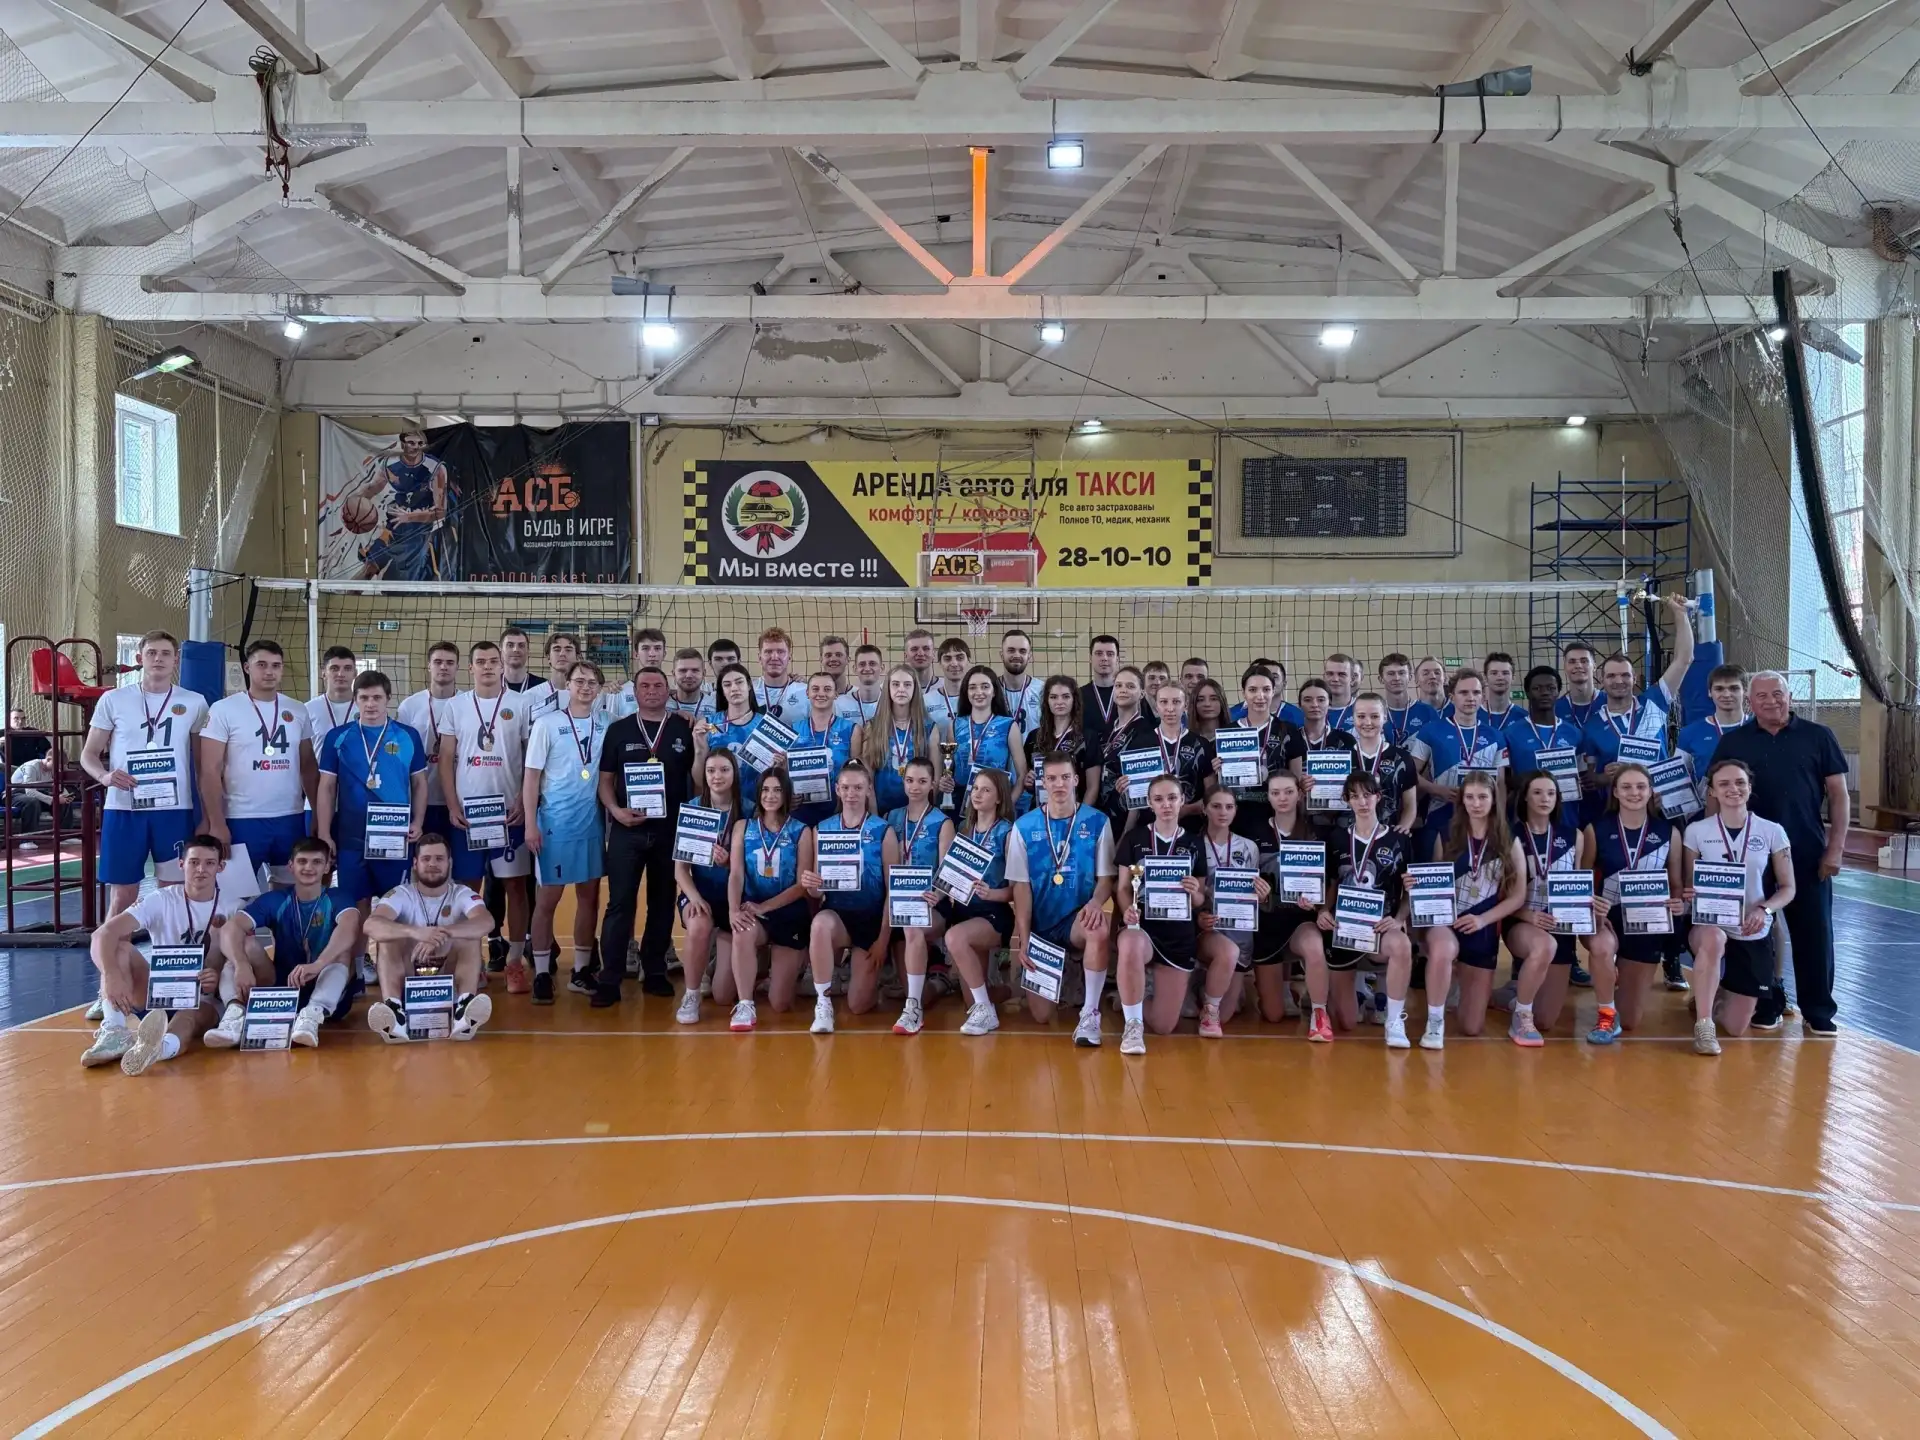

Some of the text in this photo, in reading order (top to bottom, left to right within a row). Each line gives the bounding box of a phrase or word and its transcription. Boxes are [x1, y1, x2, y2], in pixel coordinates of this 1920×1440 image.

[852, 471, 1155, 500] АРЕНДА авто для ТАКСИ
[493, 477, 580, 512] АСБ
[1059, 503, 1155, 513] Все авто застрахованы
[868, 504, 943, 526] комфорт
[1059, 516, 1171, 526] Полное ТО, медик, механик
[523, 517, 614, 538] БУДЬ В ИГРЕ
[1058, 546, 1171, 567] 28-10-10
[718, 558, 878, 578] Мы вместе !!!
[932, 554, 982, 577] АСБ
[140, 717, 173, 747] 11
[759, 722, 790, 745] ДИПЛОМ
[255, 724, 290, 755] 14
[1220, 739, 1255, 749] ДИПЛОМ
[1623, 746, 1656, 757] ДИПЛОМ
[131, 760, 172, 772] ДИПЛОМ
[252, 760, 271, 771] MG
[792, 757, 824, 768] ДИПЛОМ
[1126, 759, 1159, 772] ДИПЛОМ
[1311, 762, 1347, 771] ДИПЛОМ
[1541, 758, 1573, 769] ДИПЛОМ
[629, 773, 660, 783] ДИПЛОМ
[1653, 767, 1684, 783] ДИПЛОМ
[468, 804, 502, 815] ДИПЛОМ
[371, 814, 406, 823] ДИПЛОМ
[682, 815, 716, 828] ДИПЛОМ
[821, 842, 857, 851] ДИПЛОМ
[952, 846, 985, 868] ДИПЛОМ
[1284, 852, 1321, 862] ДИПЛОМ
[554, 864, 562, 878] 1
[1149, 869, 1186, 877] ДИПЛОМ
[893, 878, 928, 886] ДИПЛОМ
[1218, 880, 1253, 888] ДИПЛОМ
[1414, 875, 1450, 885] ДИПЛОМ
[1699, 873, 1741, 884] ДИПЛОМ
[1553, 883, 1589, 891] ДИПЛОМ
[1625, 882, 1664, 892] ДИПЛОМ
[1341, 899, 1379, 910] ДИПЛОМ
[1030, 946, 1060, 964] ДИПЛОМ
[156, 957, 198, 967] ДИПЛОМ
[410, 988, 448, 999] ДИПЛОМ
[253, 999, 293, 1009] ДИПЛОМ
